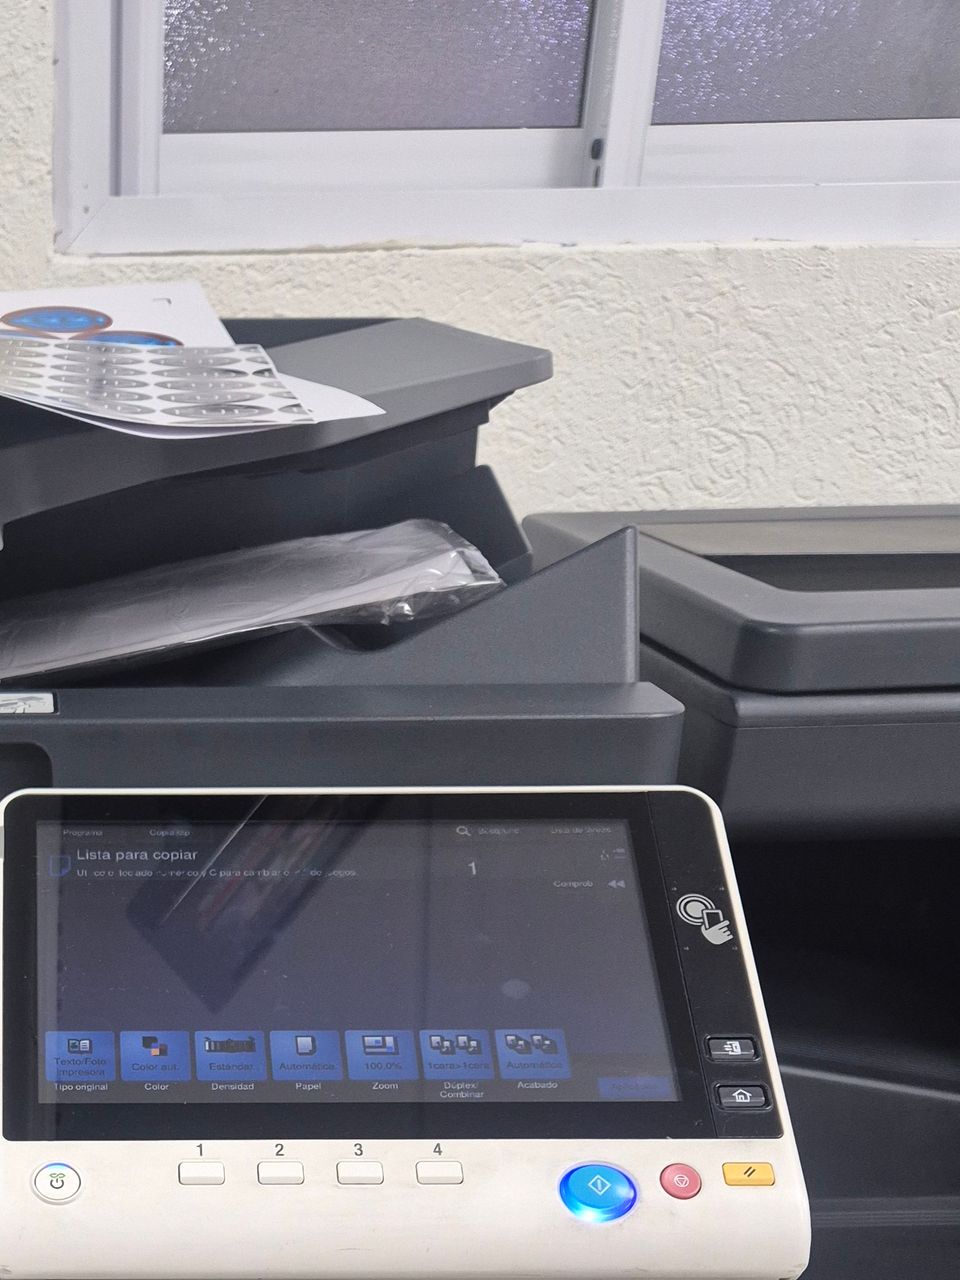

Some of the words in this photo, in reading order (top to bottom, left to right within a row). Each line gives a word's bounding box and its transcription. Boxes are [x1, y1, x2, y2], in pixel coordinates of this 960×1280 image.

[76, 849, 111, 861] Lista
[115, 851, 149, 862] para
[153, 850, 198, 863] copiar
[467, 861, 477, 876] 1
[132, 1063, 157, 1071] Color
[54, 1083, 74, 1092] Tipo
[76, 1082, 108, 1092] original
[144, 1082, 169, 1091] Color
[211, 1082, 255, 1091] Densidad
[295, 1082, 322, 1091] Papel
[372, 1081, 399, 1090] Zoom
[517, 1081, 559, 1089] Acabado
[439, 1090, 485, 1099] Combinar
[197, 1143, 203, 1156] 1
[275, 1143, 284, 1156] 2
[354, 1143, 363, 1156] 3
[433, 1143, 442, 1156] 4
